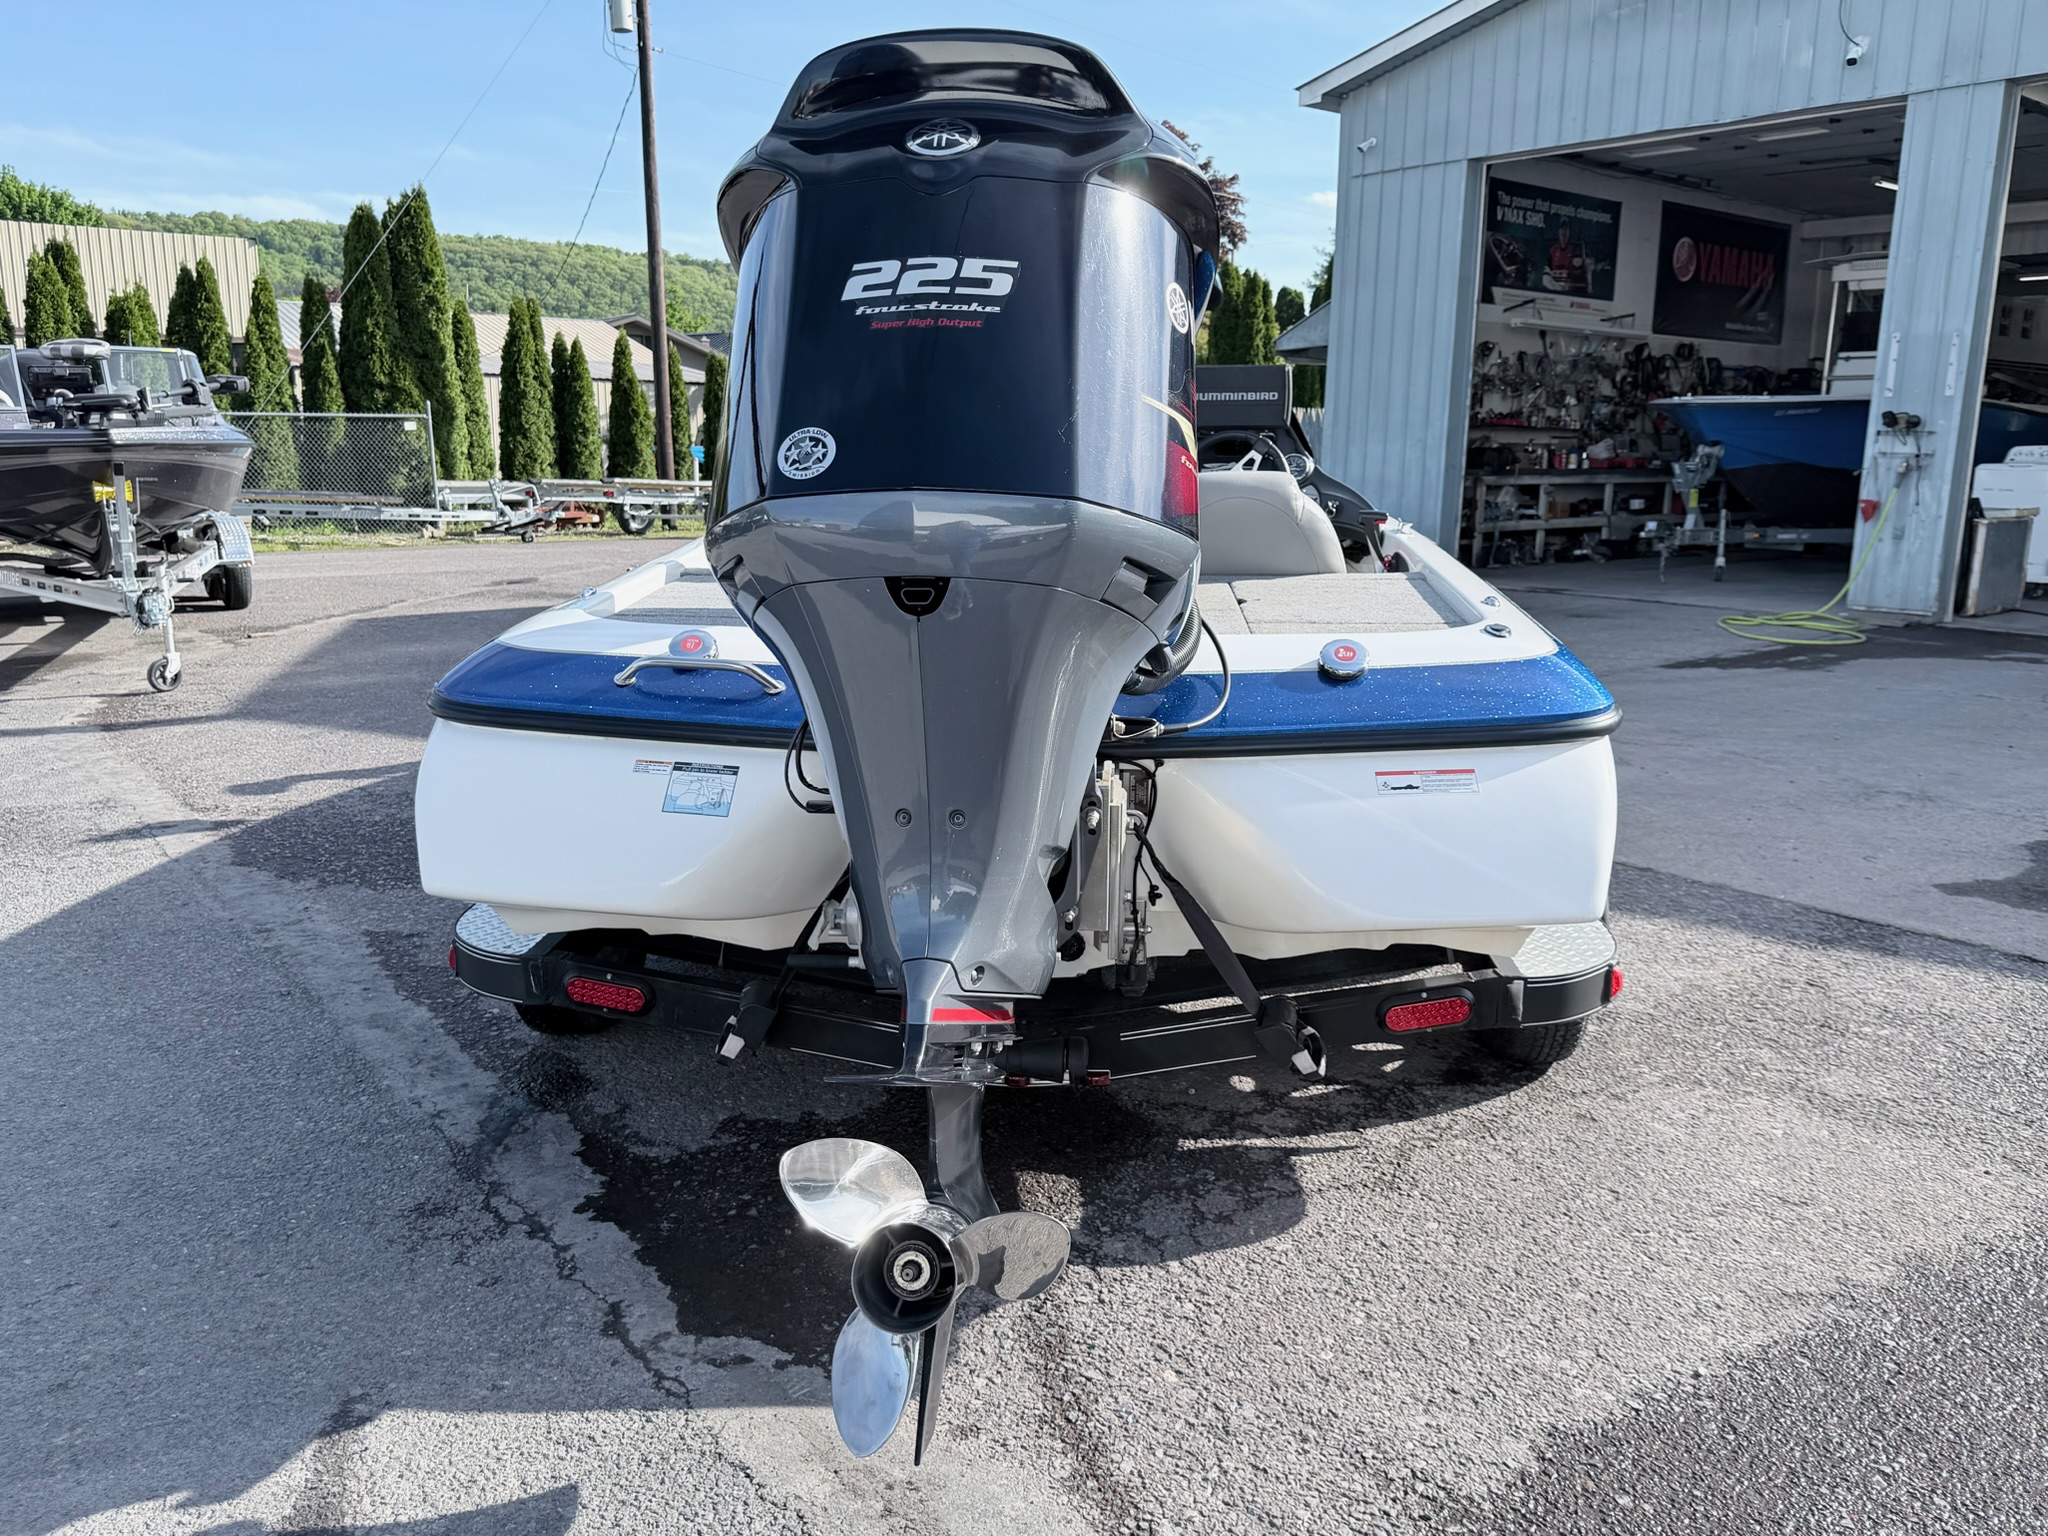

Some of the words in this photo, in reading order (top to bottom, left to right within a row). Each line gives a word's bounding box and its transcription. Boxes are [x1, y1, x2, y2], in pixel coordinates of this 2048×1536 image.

[840, 256, 1020, 302] 225
[1698, 242, 1776, 291] YAMAHA
[870, 320, 904, 331] Super
[907, 317, 935, 328] High
[938, 317, 983, 329] Output
[788, 429, 811, 442] ULTRA
[812, 429, 829, 439] LOW
